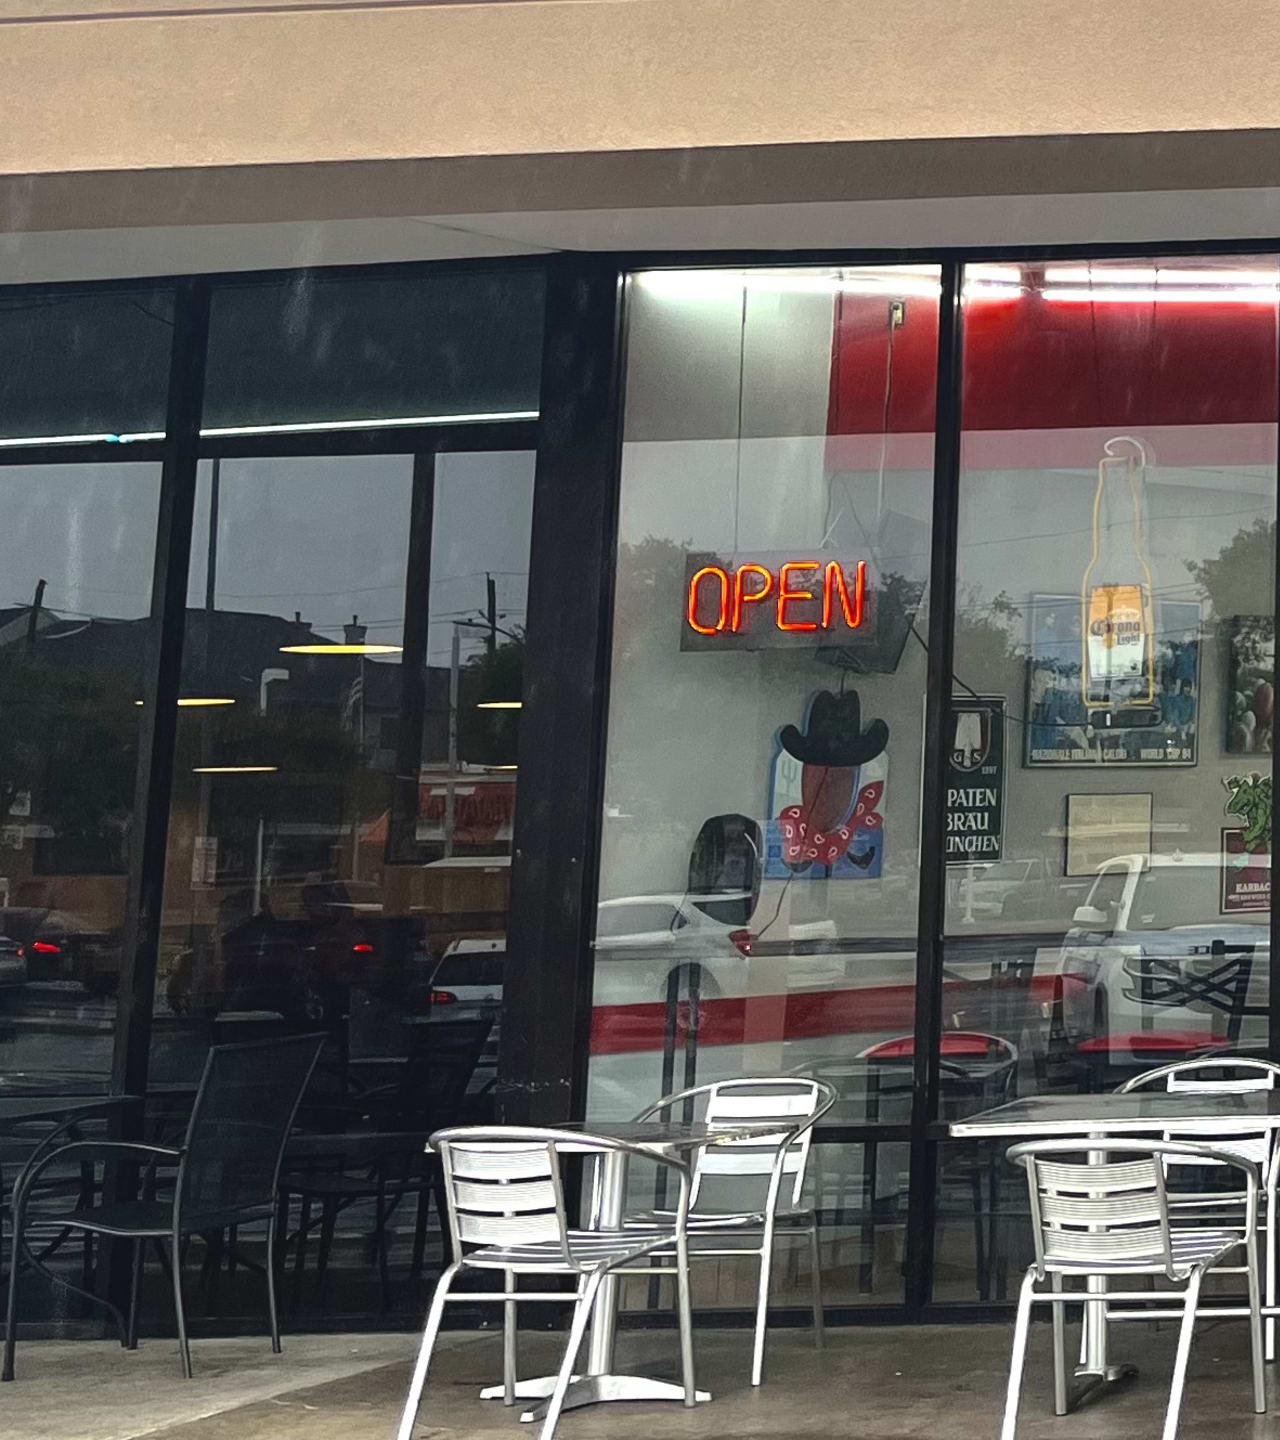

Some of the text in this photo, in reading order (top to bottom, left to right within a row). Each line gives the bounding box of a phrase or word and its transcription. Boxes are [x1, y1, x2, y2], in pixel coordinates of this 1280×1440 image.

[687, 560, 866, 634] OPEN
[1091, 620, 1140, 637] Corona
[1117, 634, 1140, 646] Light
[947, 788, 997, 807] PATEN
[1236, 882, 1271, 893] KARBAC
